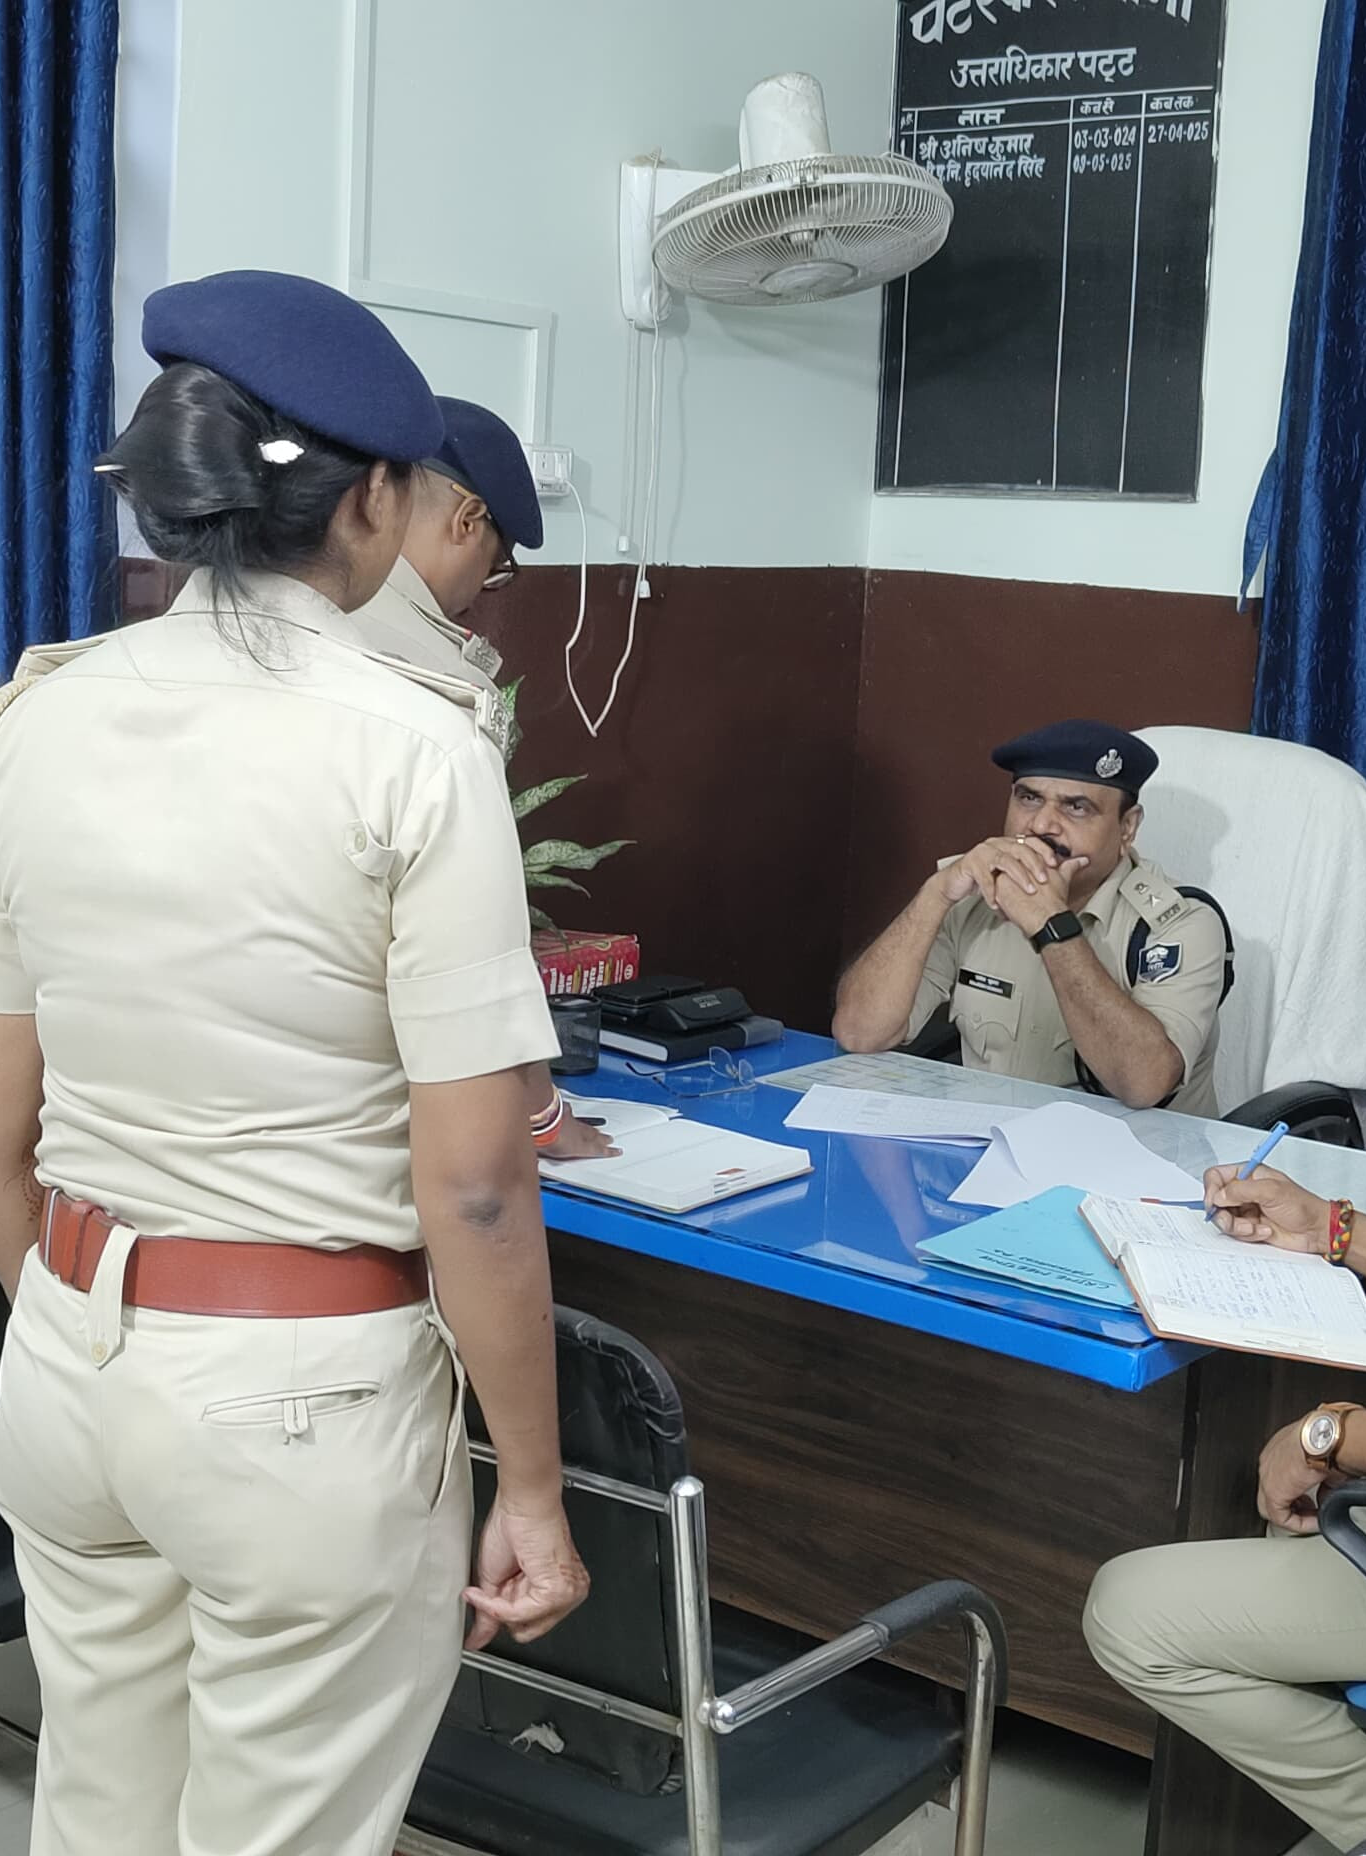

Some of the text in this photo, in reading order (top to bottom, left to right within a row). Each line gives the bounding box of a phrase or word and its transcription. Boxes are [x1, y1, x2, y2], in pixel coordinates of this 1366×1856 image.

[950, 45, 1075, 88] उत्तराधिकार
[958, 108, 1006, 126] नाम
[919, 135, 938, 161] श्री
[988, 133, 1034, 161] कुमार
[1017, 154, 1046, 178] सिंह
